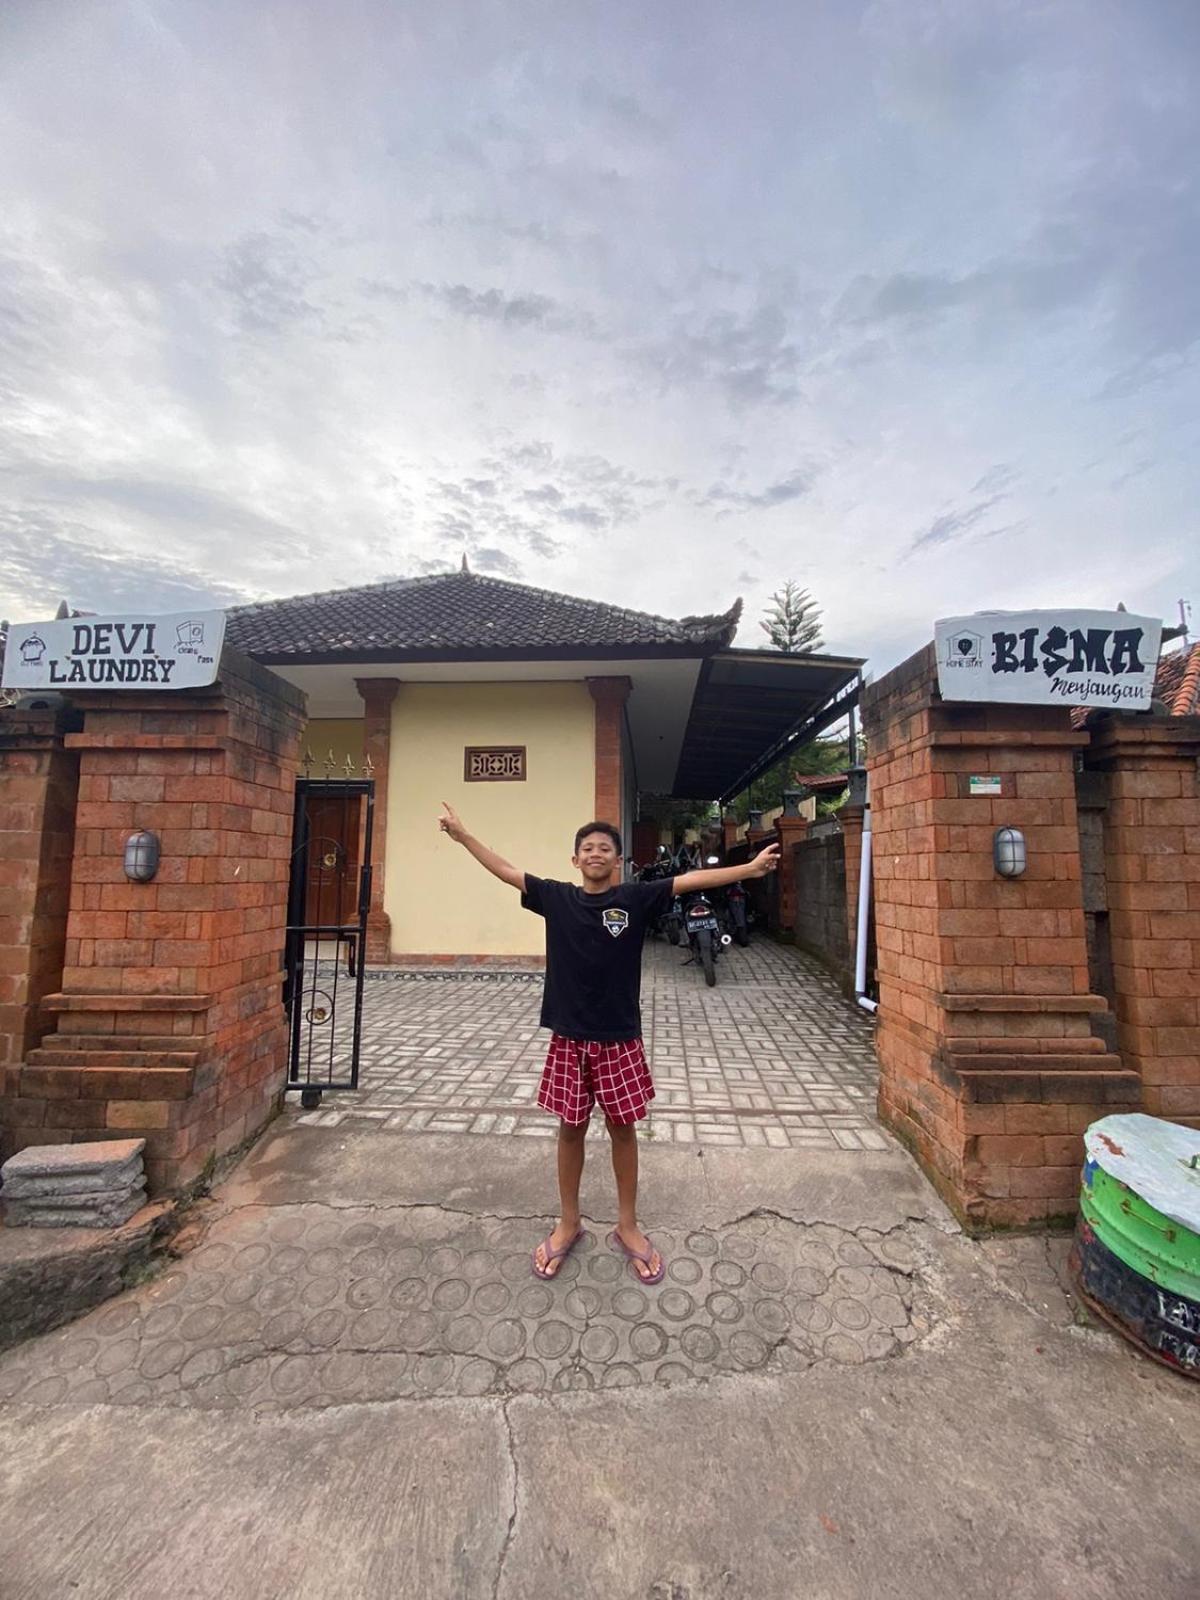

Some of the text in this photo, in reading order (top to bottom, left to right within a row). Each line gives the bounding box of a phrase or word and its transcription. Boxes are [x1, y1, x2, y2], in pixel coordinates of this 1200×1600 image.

[71, 623, 156, 656] DEVI
[991, 626, 1146, 677] BISMA
[49, 659, 176, 683] LAUNDRY
